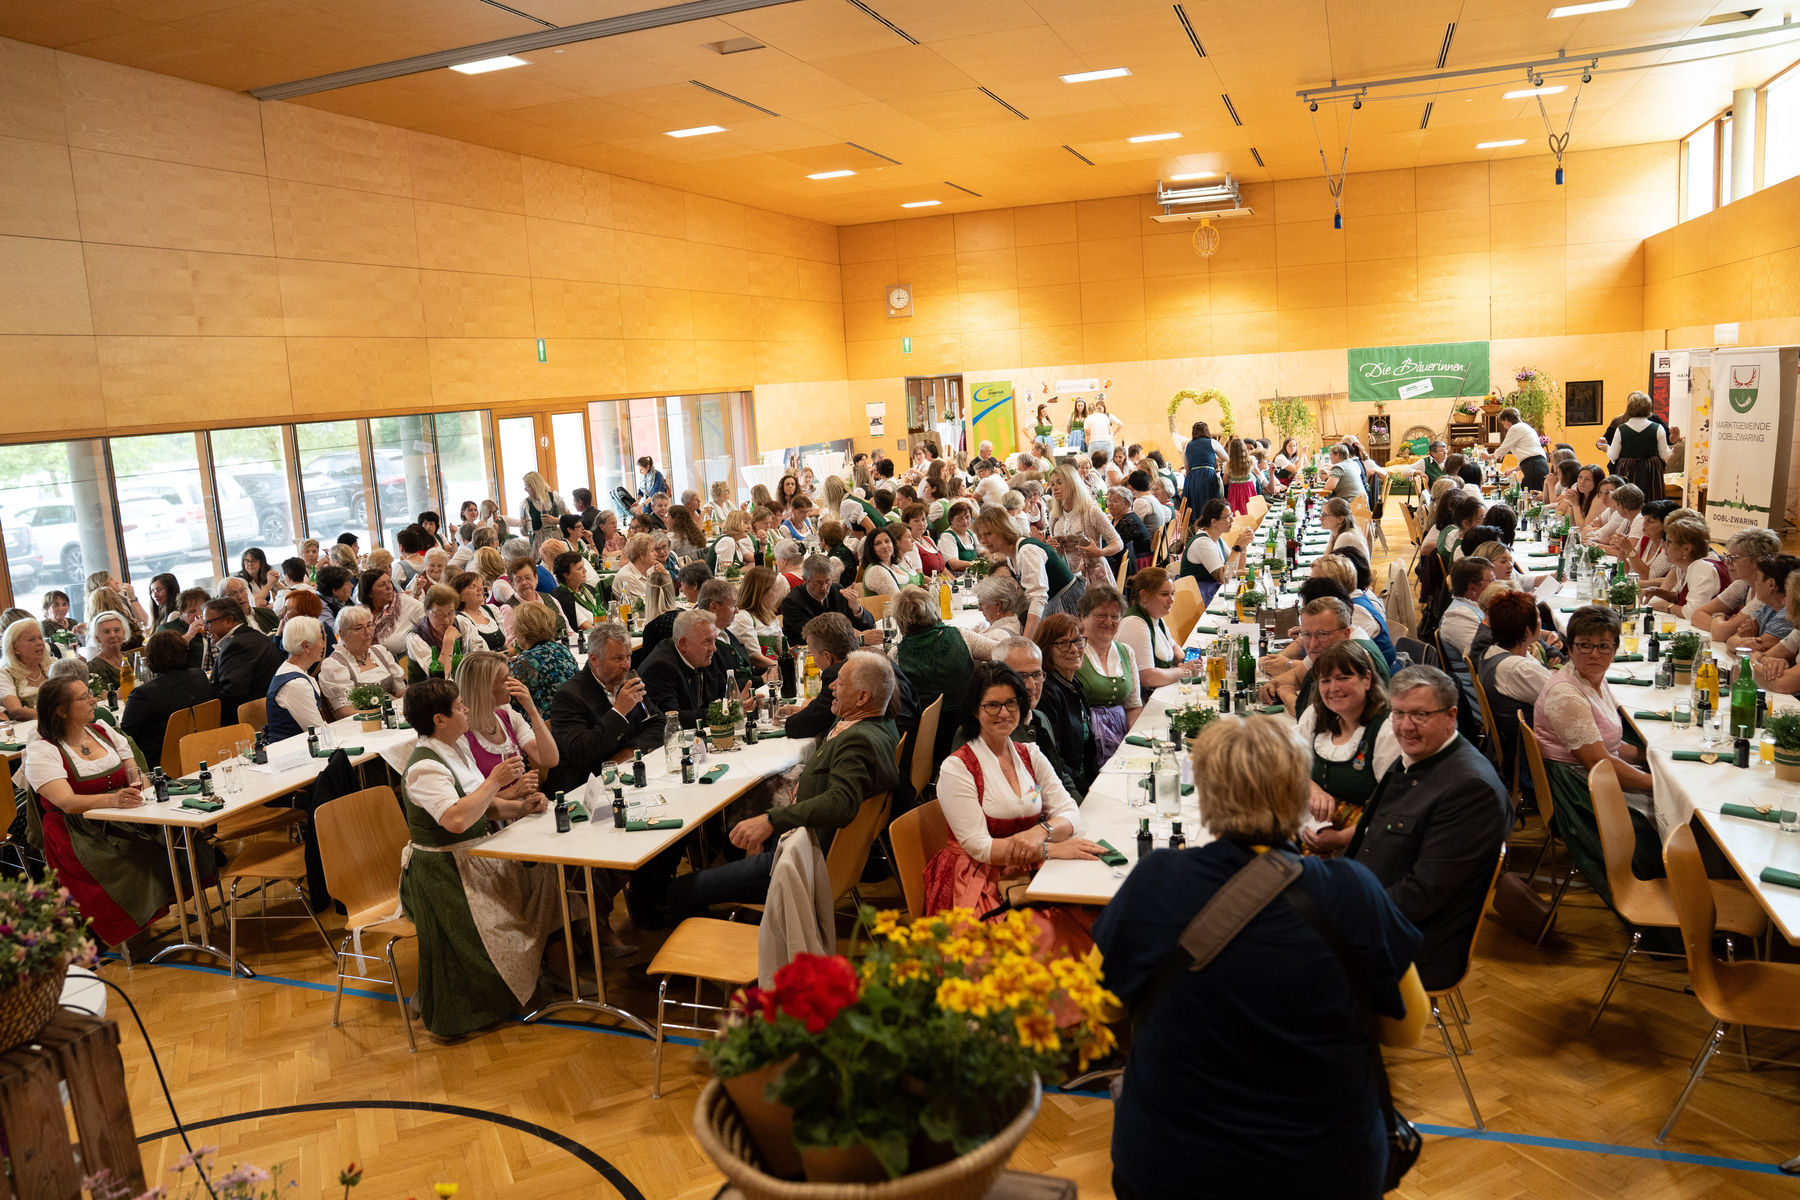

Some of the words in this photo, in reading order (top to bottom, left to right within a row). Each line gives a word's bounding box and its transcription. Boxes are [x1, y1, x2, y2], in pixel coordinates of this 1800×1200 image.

[1359, 362, 1391, 378] Die
[1716, 421, 1771, 431] MARKTGEMEINDE
[1717, 432, 1765, 442] DOBL-ZWARING
[1712, 513, 1759, 526] DOBL-ZWARING
